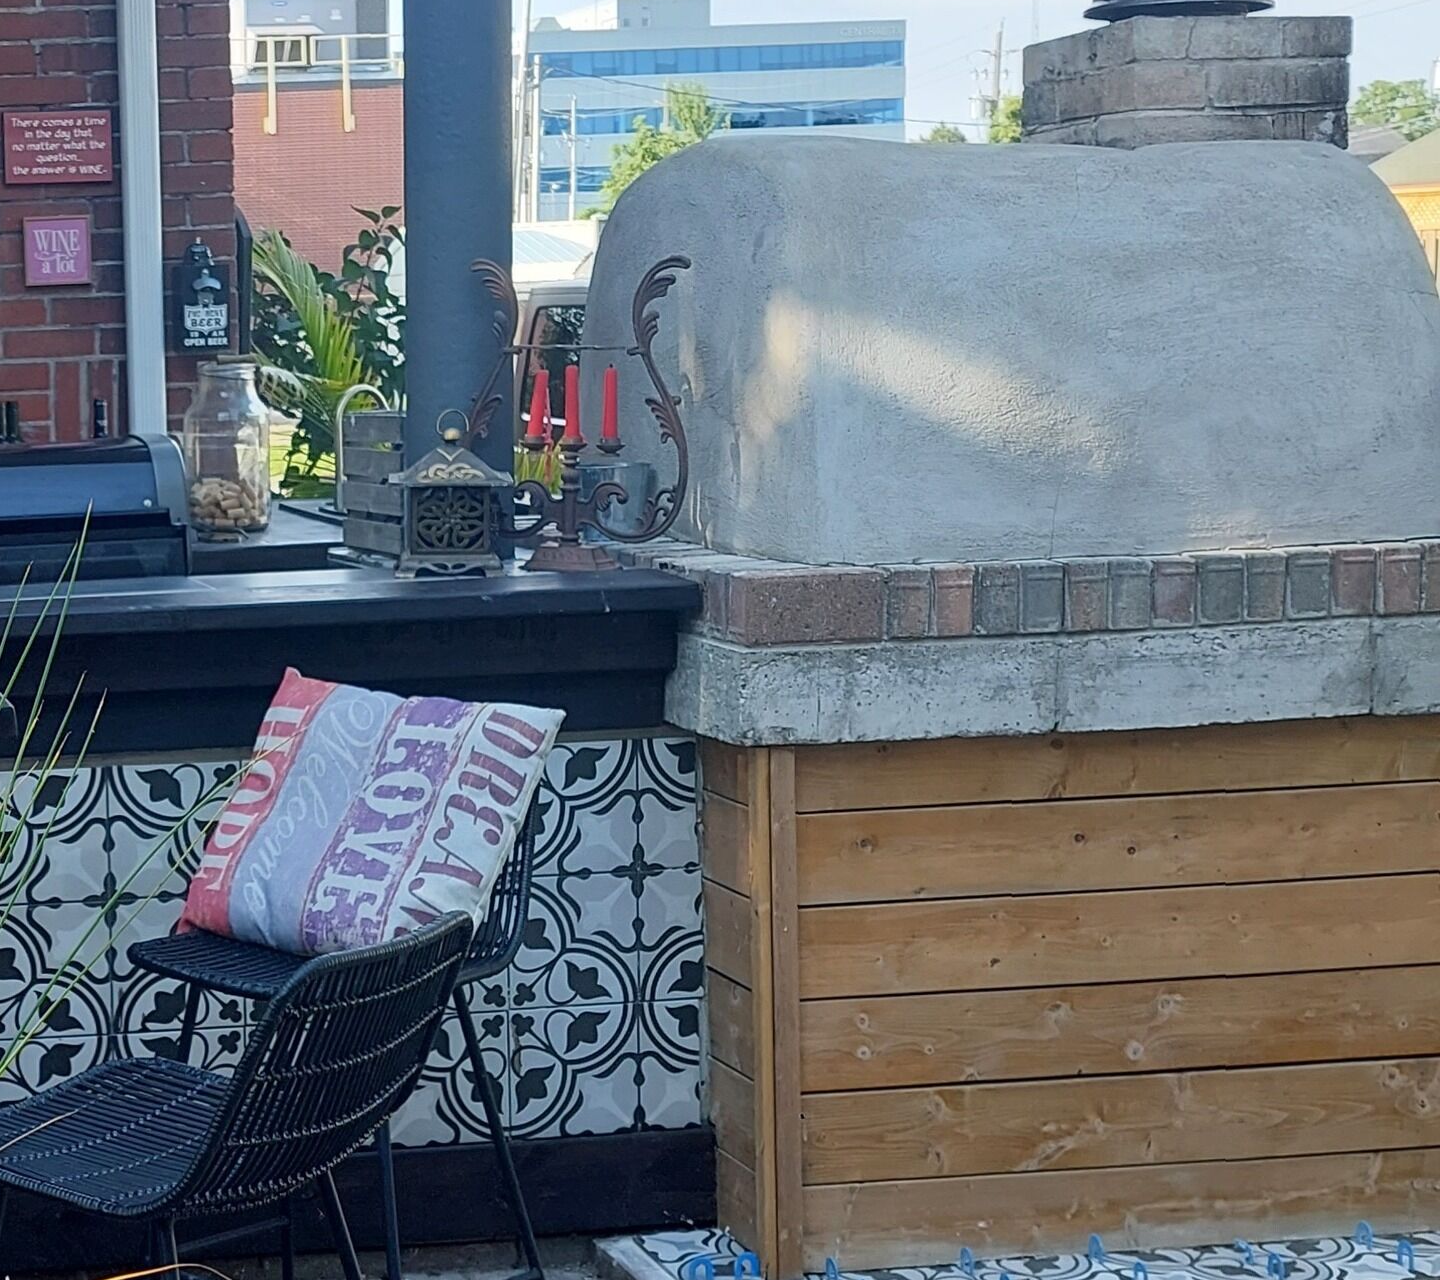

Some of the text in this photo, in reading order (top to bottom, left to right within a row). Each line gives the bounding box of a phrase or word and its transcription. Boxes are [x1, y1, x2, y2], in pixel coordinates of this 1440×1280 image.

[11, 117, 40, 128] There
[41, 118, 74, 127] comes
[84, 117, 106, 126] time
[24, 128, 93, 141] in the day that
[12, 140, 106, 151] no matter what the
[12, 165, 29, 175] the
[31, 166, 66, 175] answer
[68, 165, 77, 174] is
[32, 229, 81, 257] WINE
[42, 253, 76, 274] a lot
[192, 318, 221, 327] BEER
[244, 697, 388, 932] Welcome
[311, 717, 460, 913] LOVE
